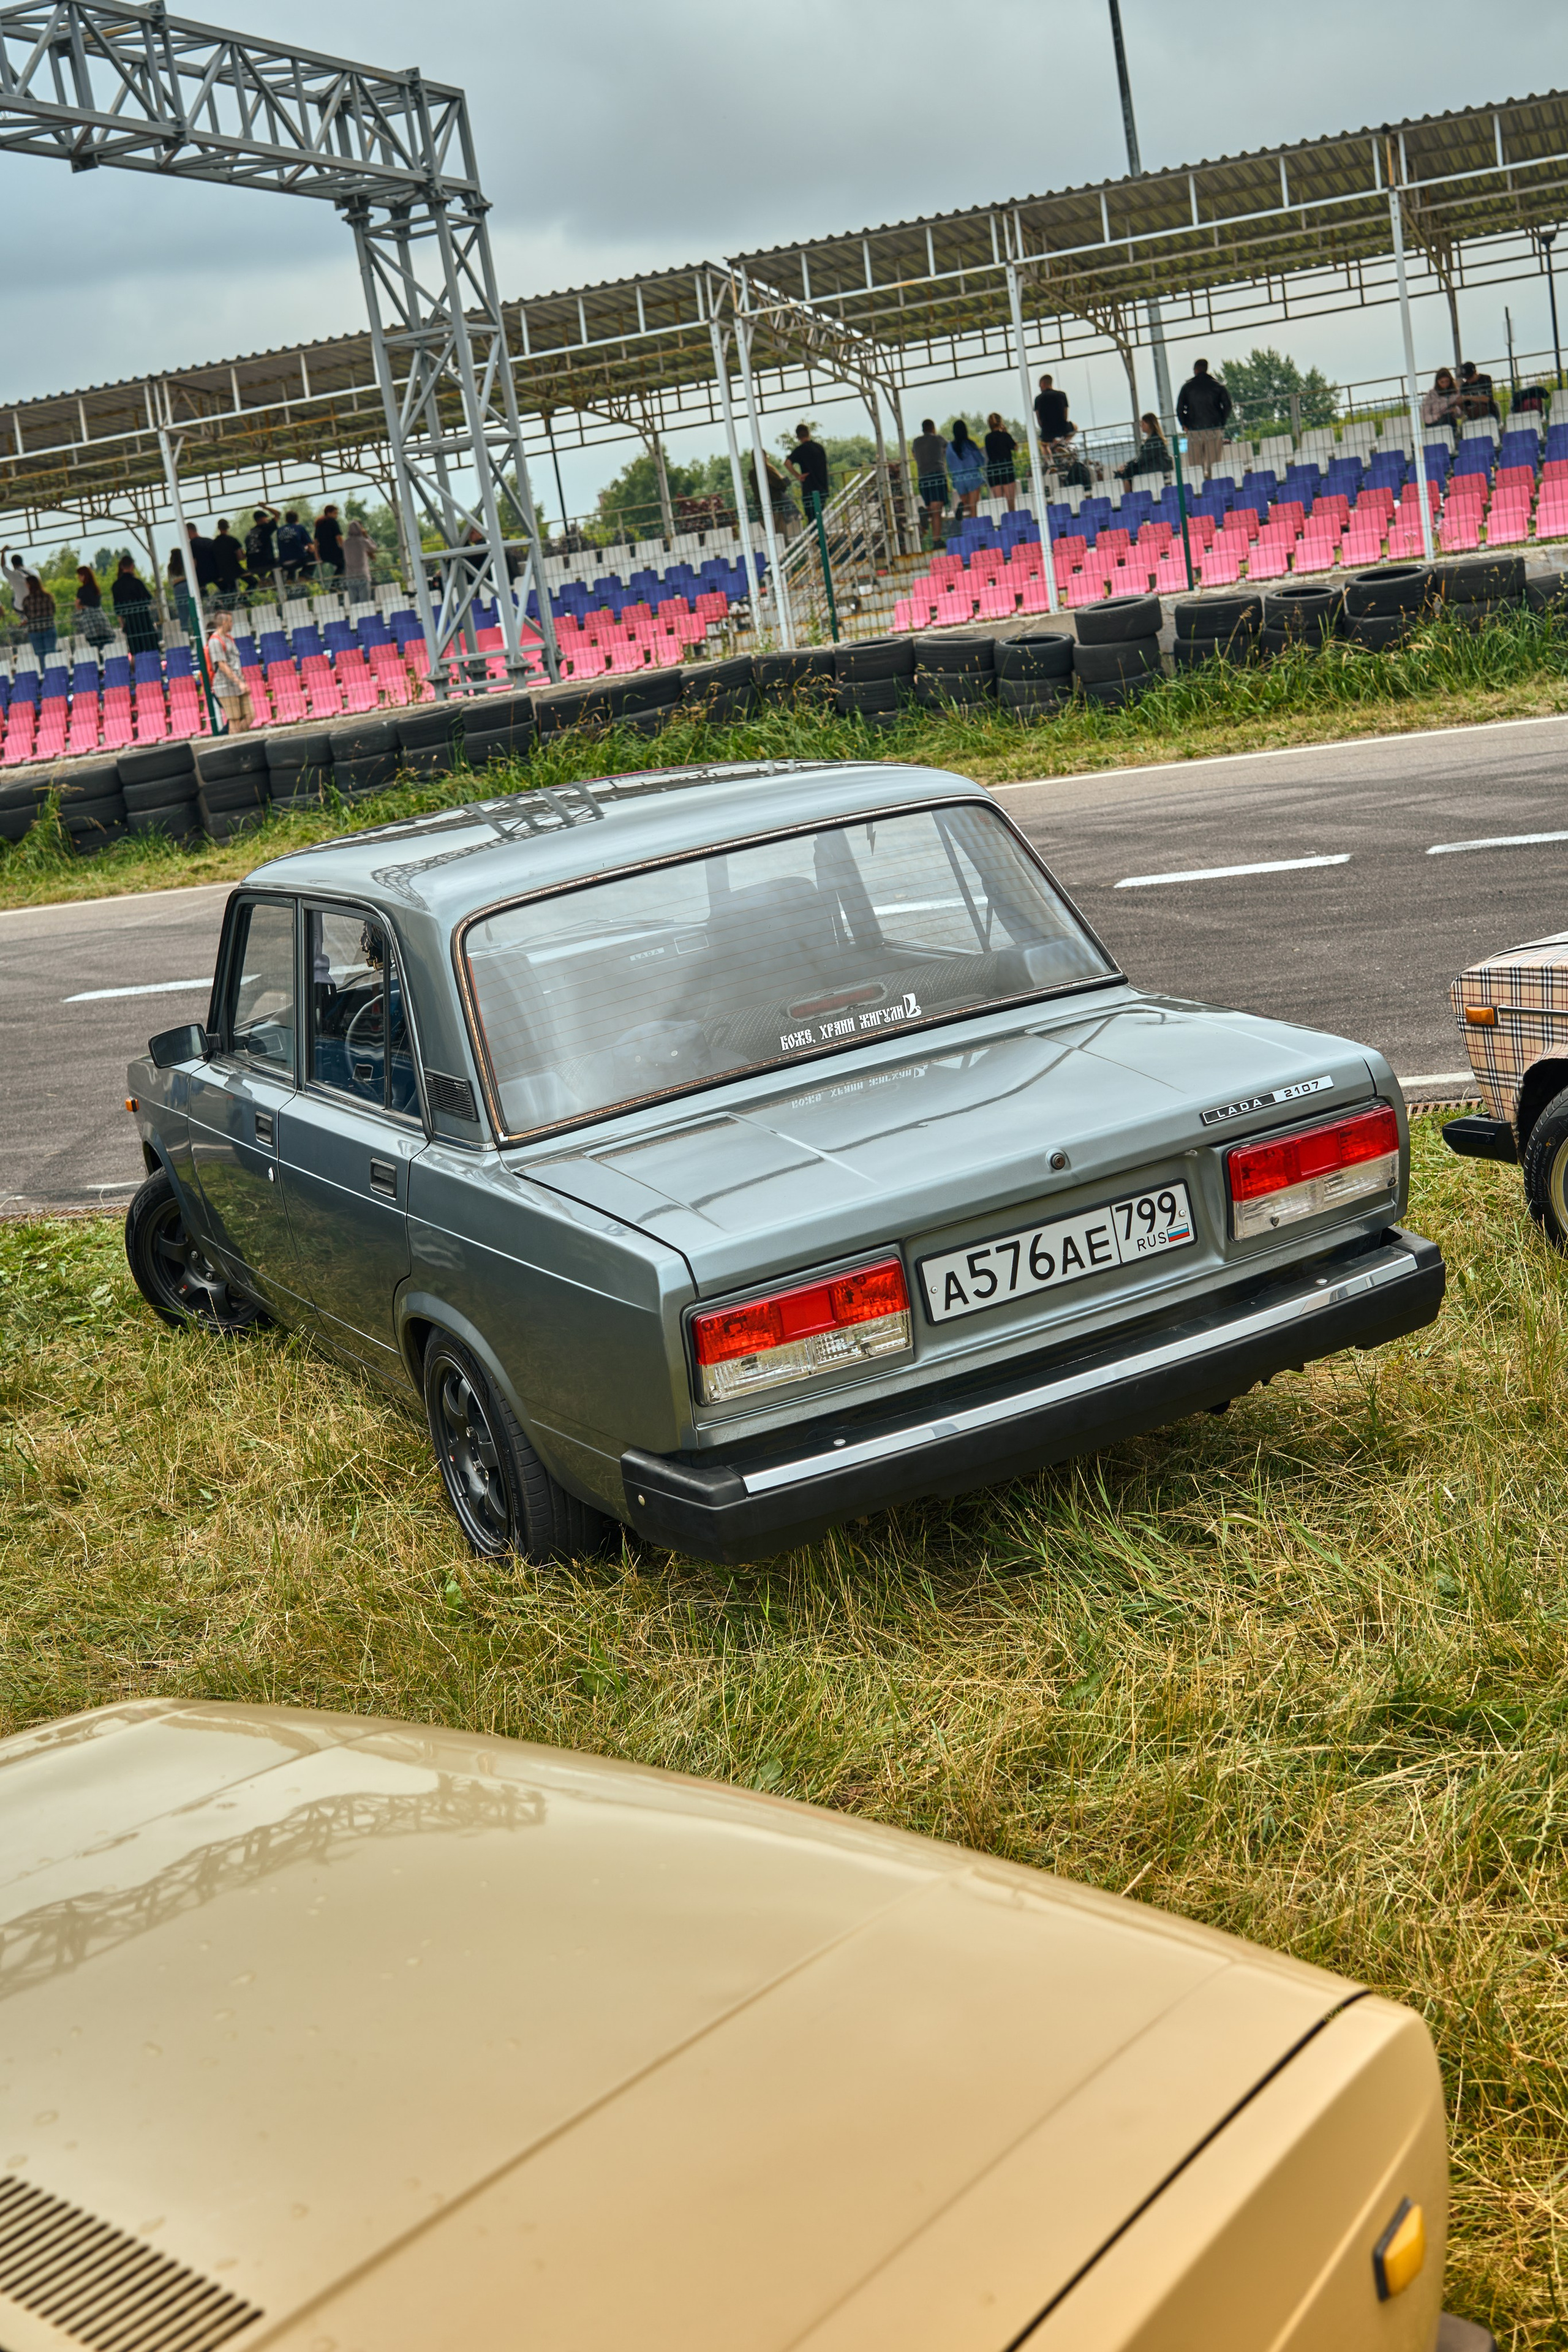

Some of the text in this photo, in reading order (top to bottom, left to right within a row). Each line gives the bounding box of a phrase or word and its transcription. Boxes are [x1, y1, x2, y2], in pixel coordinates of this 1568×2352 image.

[635, 949, 659, 959] LADA
[1216, 1081, 1319, 1118] LADA 2107
[1115, 1191, 1177, 1240] 799
[1136, 1232, 1167, 1251] RUS
